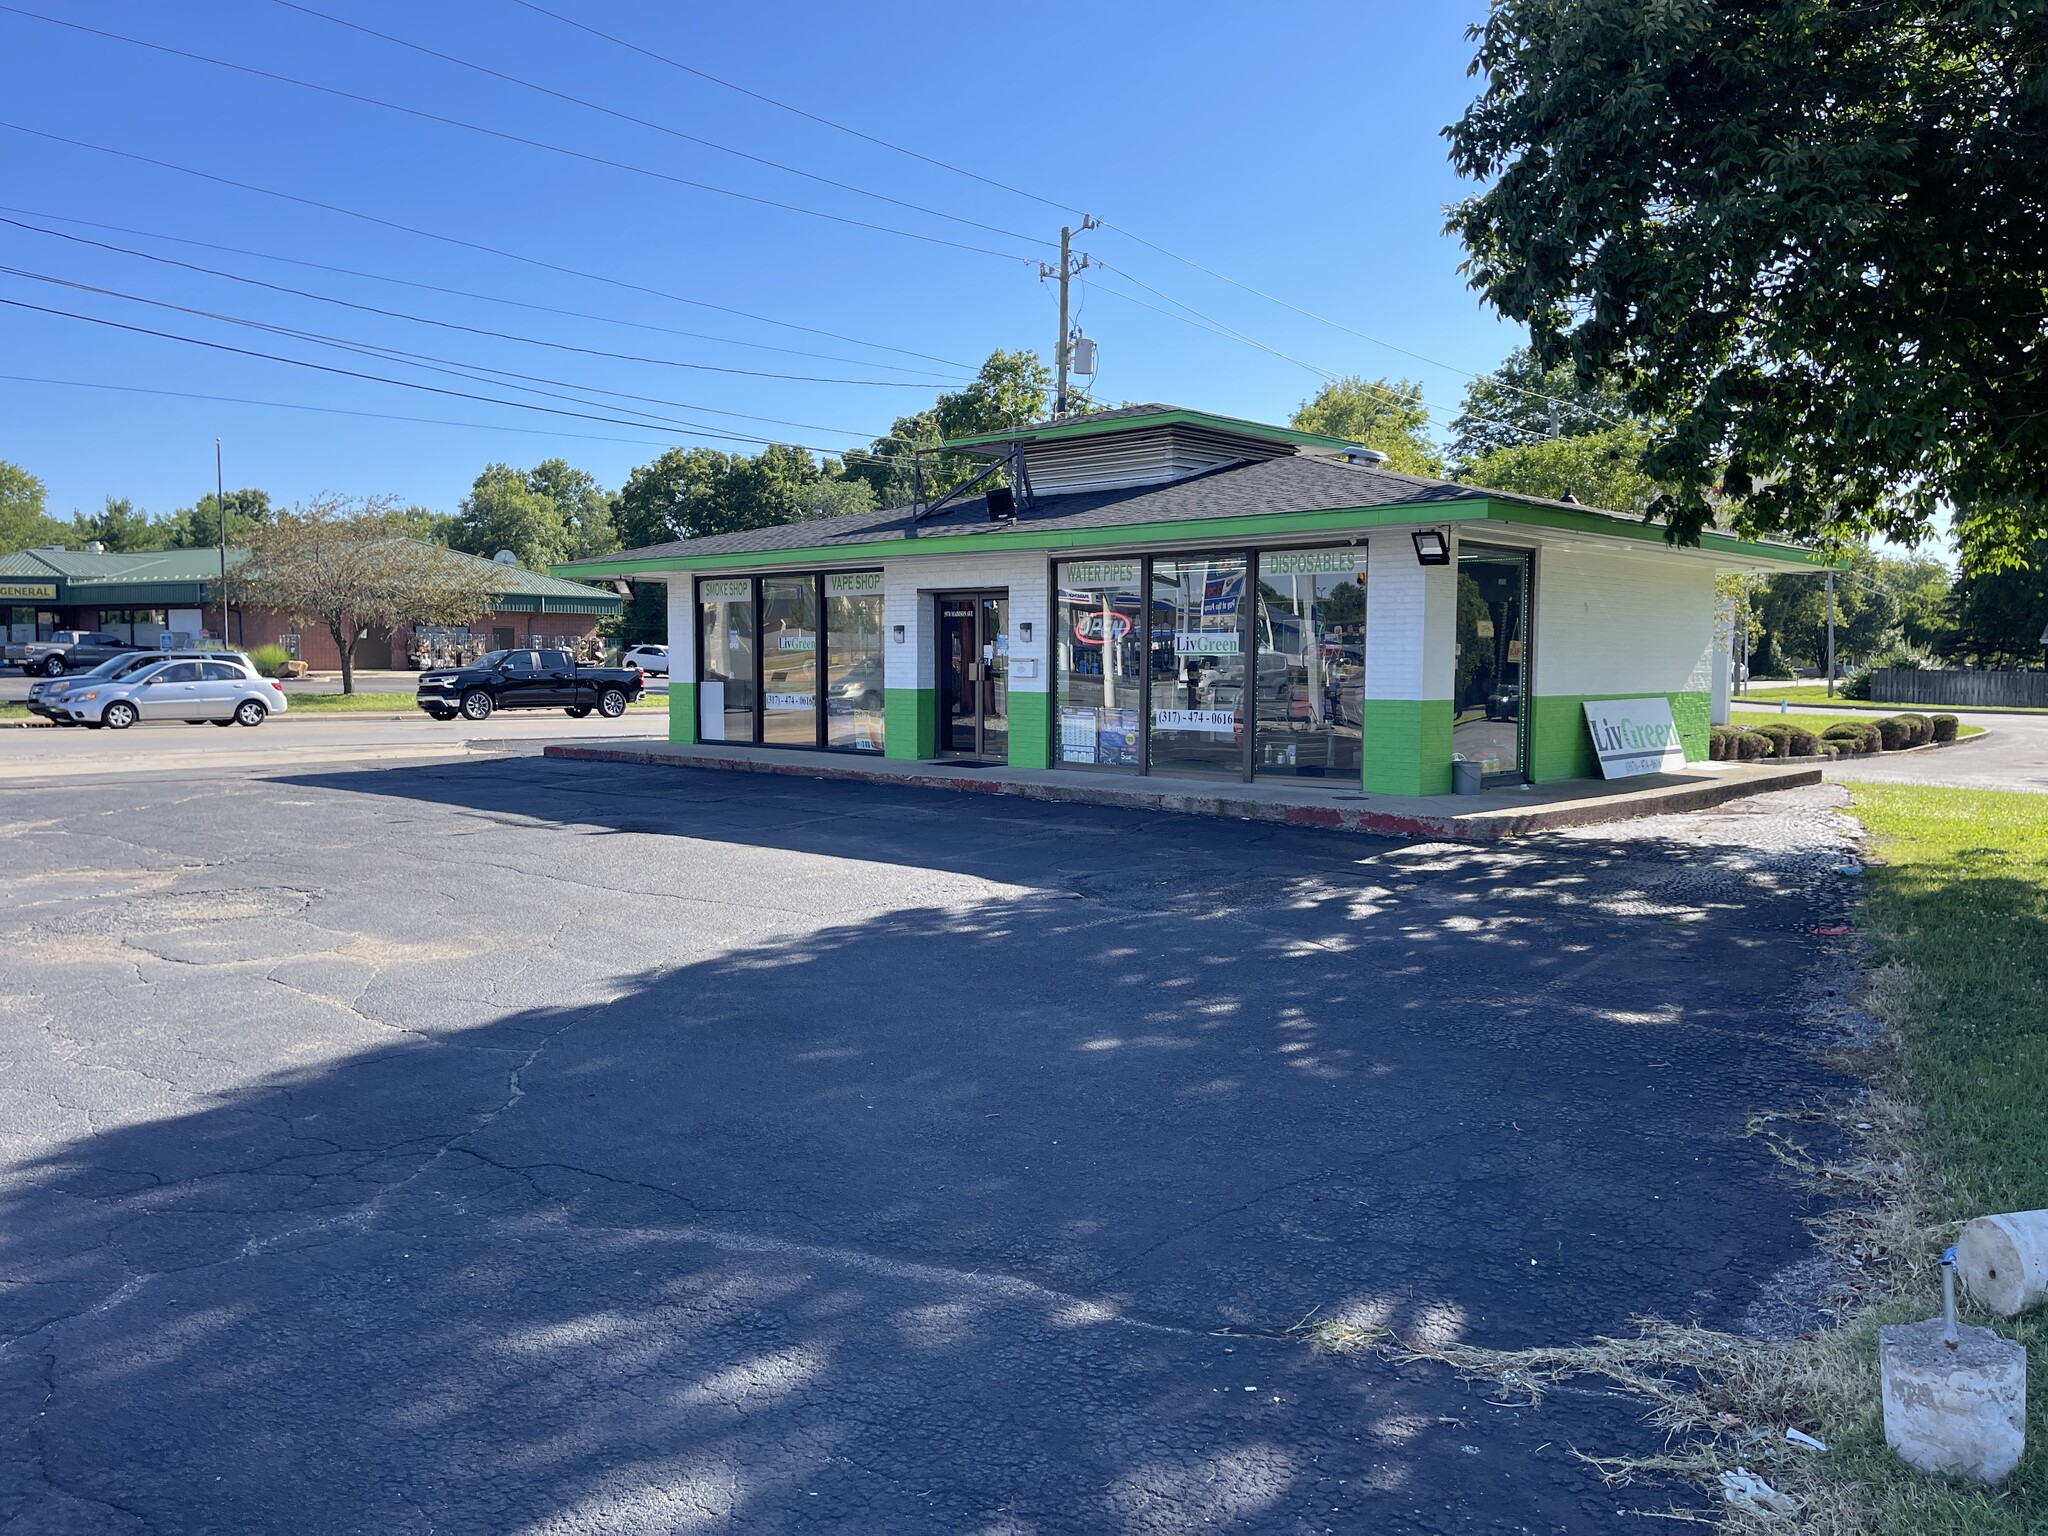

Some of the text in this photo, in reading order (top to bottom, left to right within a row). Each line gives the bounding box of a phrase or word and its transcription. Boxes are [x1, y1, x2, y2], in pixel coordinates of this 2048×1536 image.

[1270, 552, 1355, 574] DISPOSABLES
[1067, 563, 1133, 583] WATER PIPES
[705, 582, 748, 597] SMOKE SHOP
[831, 574, 881, 591] VAPE SHOP
[0, 587, 51, 597] GENERAL
[1079, 616, 1125, 640] OPN
[779, 637, 816, 650] LivGreen
[1176, 635, 1238, 652] LivGreen
[766, 694, 781, 706] (317)
[784, 694, 795, 705] 474
[1158, 711, 1181, 725] (317)
[1188, 711, 1203, 723] 474
[1211, 712, 1233, 725] 0616
[1591, 717, 1681, 752] LivGreen
